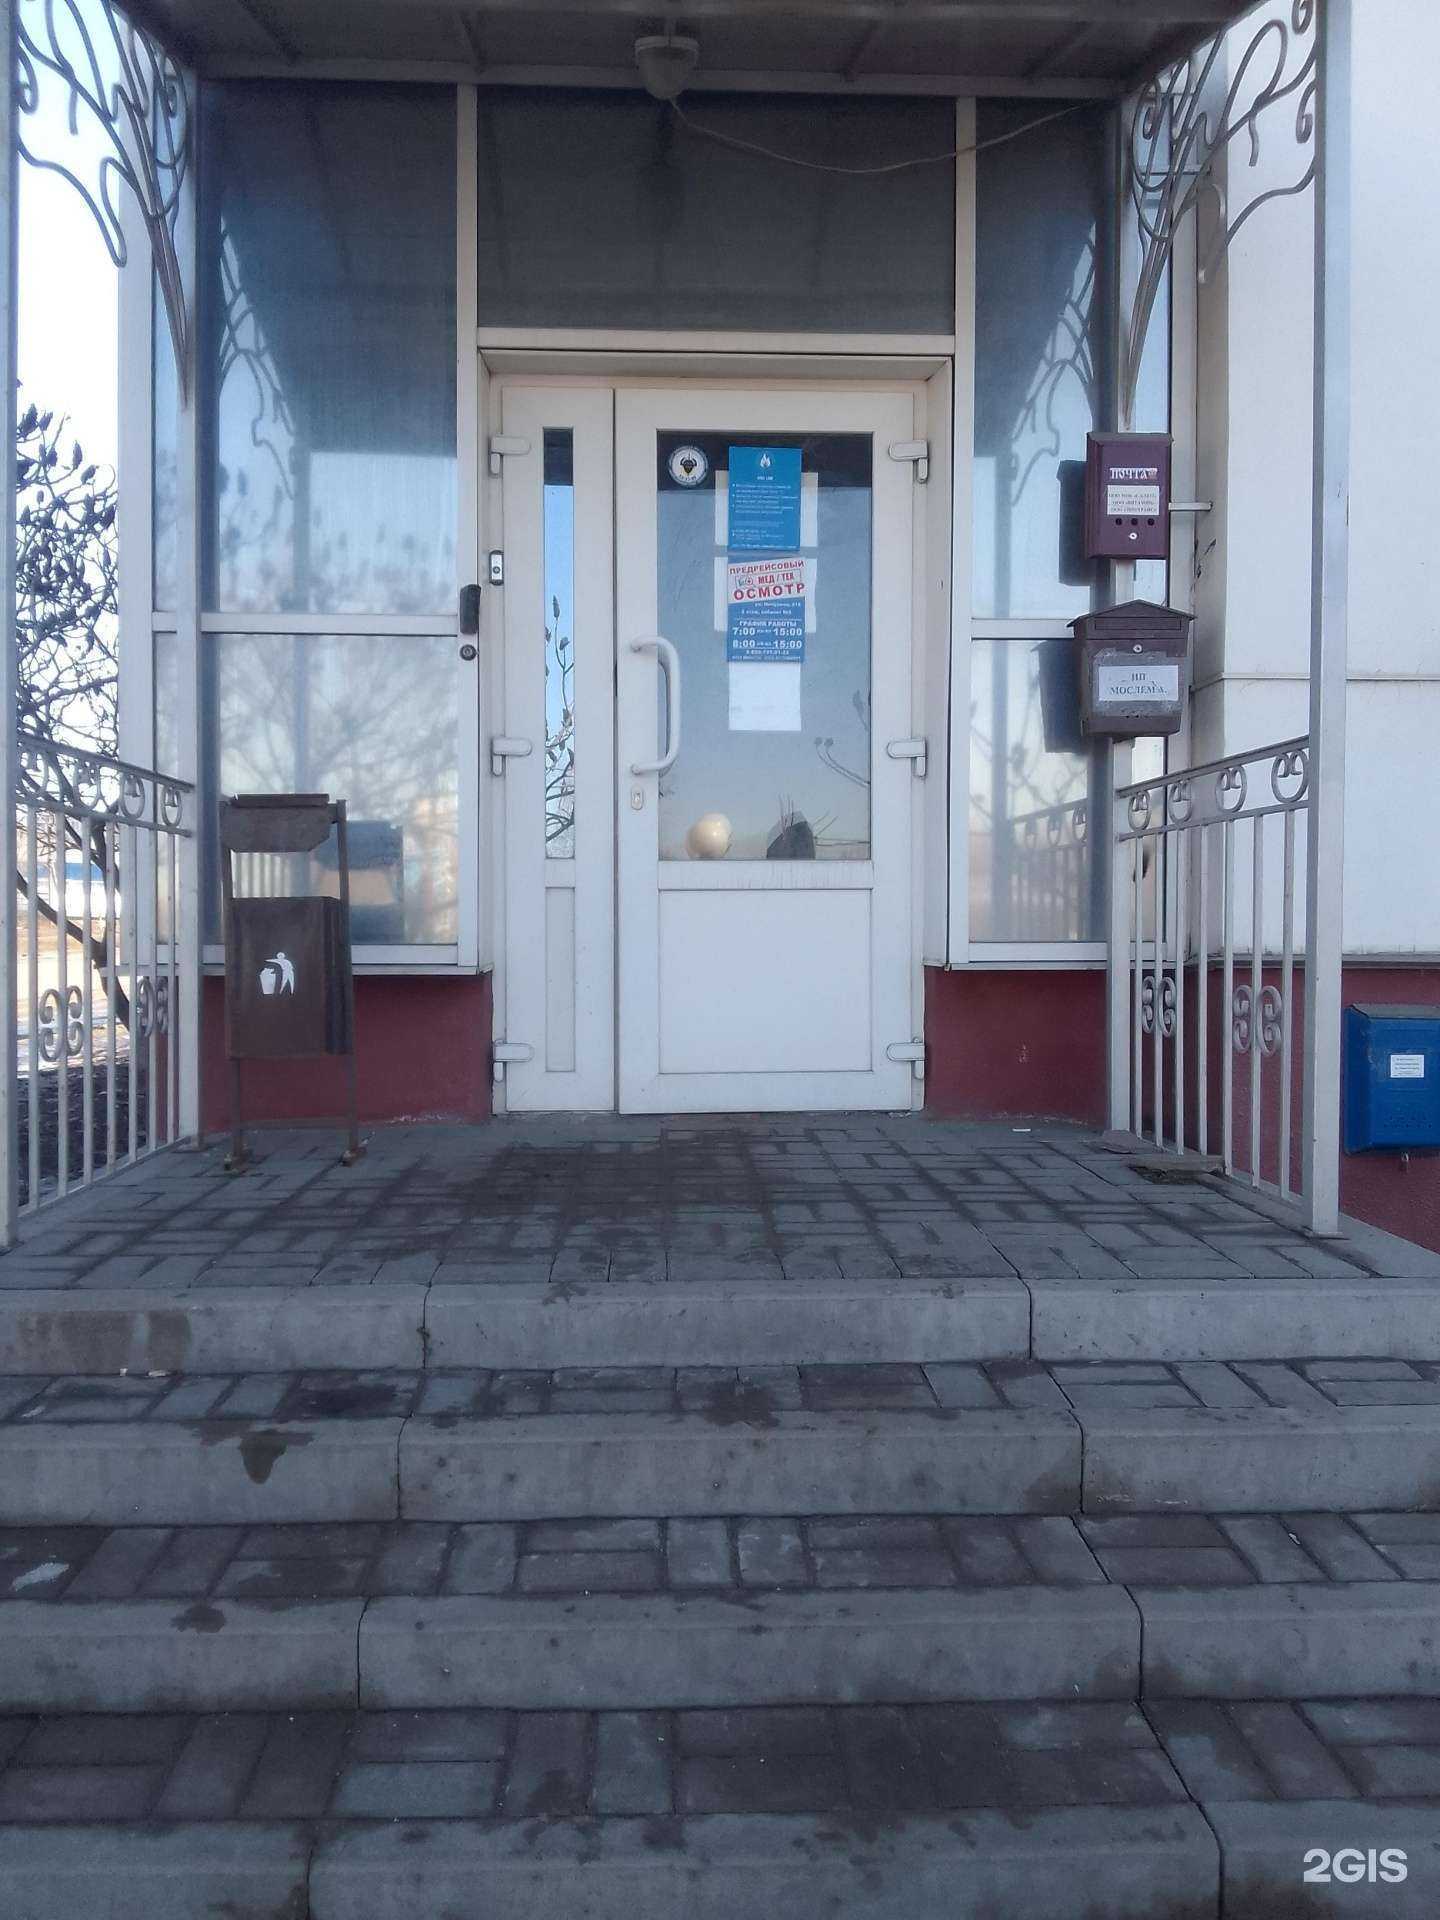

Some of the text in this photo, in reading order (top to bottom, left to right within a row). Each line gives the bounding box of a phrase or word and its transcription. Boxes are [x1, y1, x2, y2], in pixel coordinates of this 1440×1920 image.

[1111, 468, 1148, 480] ПОЧТА
[729, 559, 804, 574] ПРЕДРЕЙСОВЫЙ
[733, 583, 805, 600] ОСМОТР
[732, 627, 756, 636] 7:00
[773, 627, 803, 636] 15:00
[773, 640, 803, 649] 15:00
